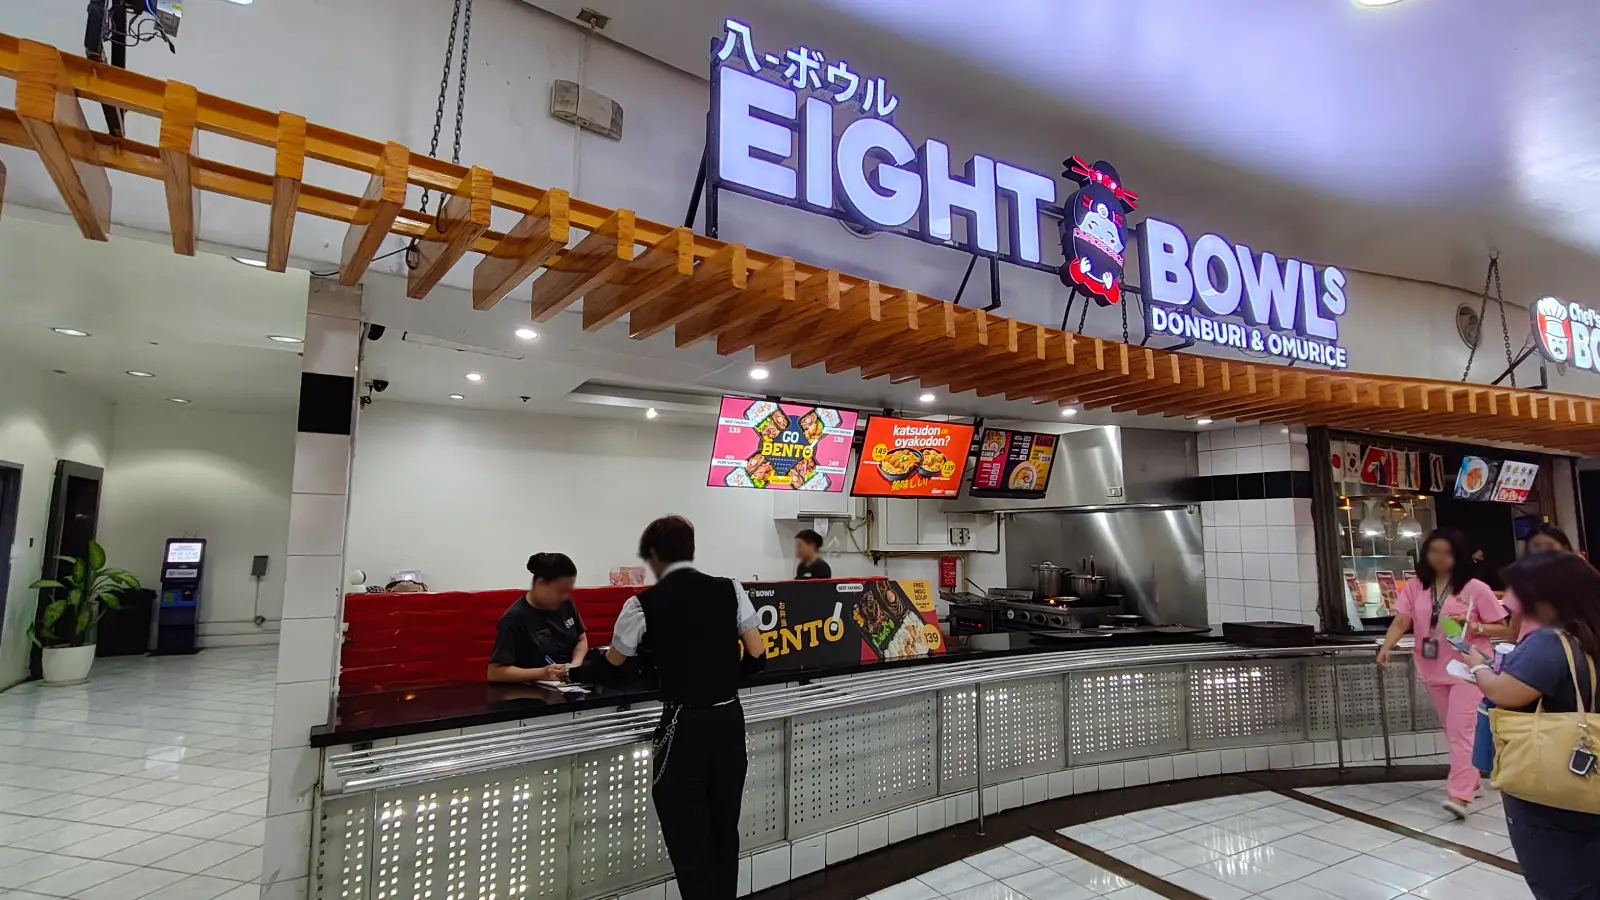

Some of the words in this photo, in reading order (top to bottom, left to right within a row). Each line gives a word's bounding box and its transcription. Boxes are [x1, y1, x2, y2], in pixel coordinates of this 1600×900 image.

[719, 66, 1056, 264] EIGHT
[1146, 218, 1347, 340] BOWLS
[1152, 307, 1248, 349] DONBURI
[1251, 334, 1265, 352] &
[1267, 333, 1347, 368] OMURICE
[728, 426, 741, 434] 139
[893, 425, 941, 436] katsudon
[782, 430, 800, 443] GO
[894, 436, 951, 448] oyakodon?
[761, 442, 814, 459] BENTO
[875, 447, 887, 455] 149
[739, 616, 844, 661] ENTO
[923, 632, 939, 643] 139
